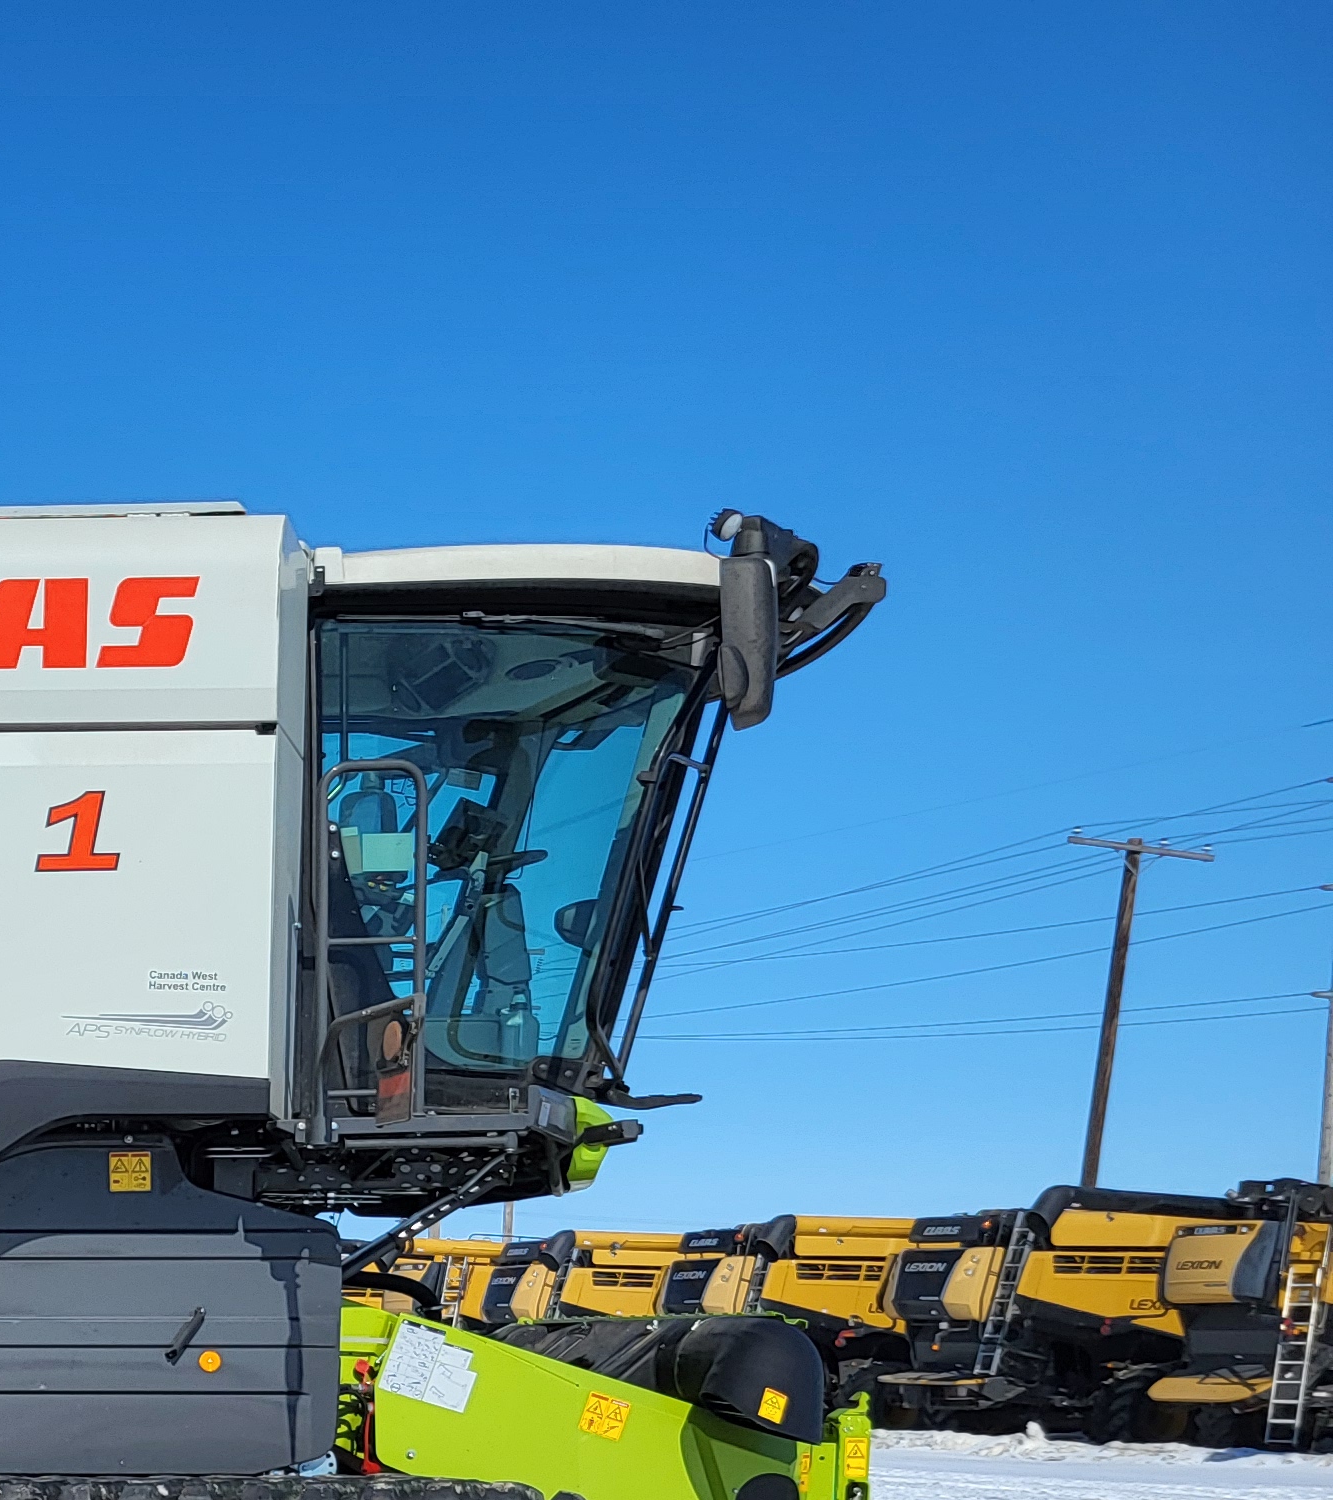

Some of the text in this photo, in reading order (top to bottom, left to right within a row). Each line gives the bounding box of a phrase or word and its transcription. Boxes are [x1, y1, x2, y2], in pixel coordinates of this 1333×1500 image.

[36, 790, 120, 873] 1
[148, 970, 218, 981] Canada West
[148, 980, 227, 992] Harvest Centre
[66, 1022, 114, 1039] APS
[904, 1262, 948, 1273] LEXION
[1175, 1260, 1223, 1271] LEXION
